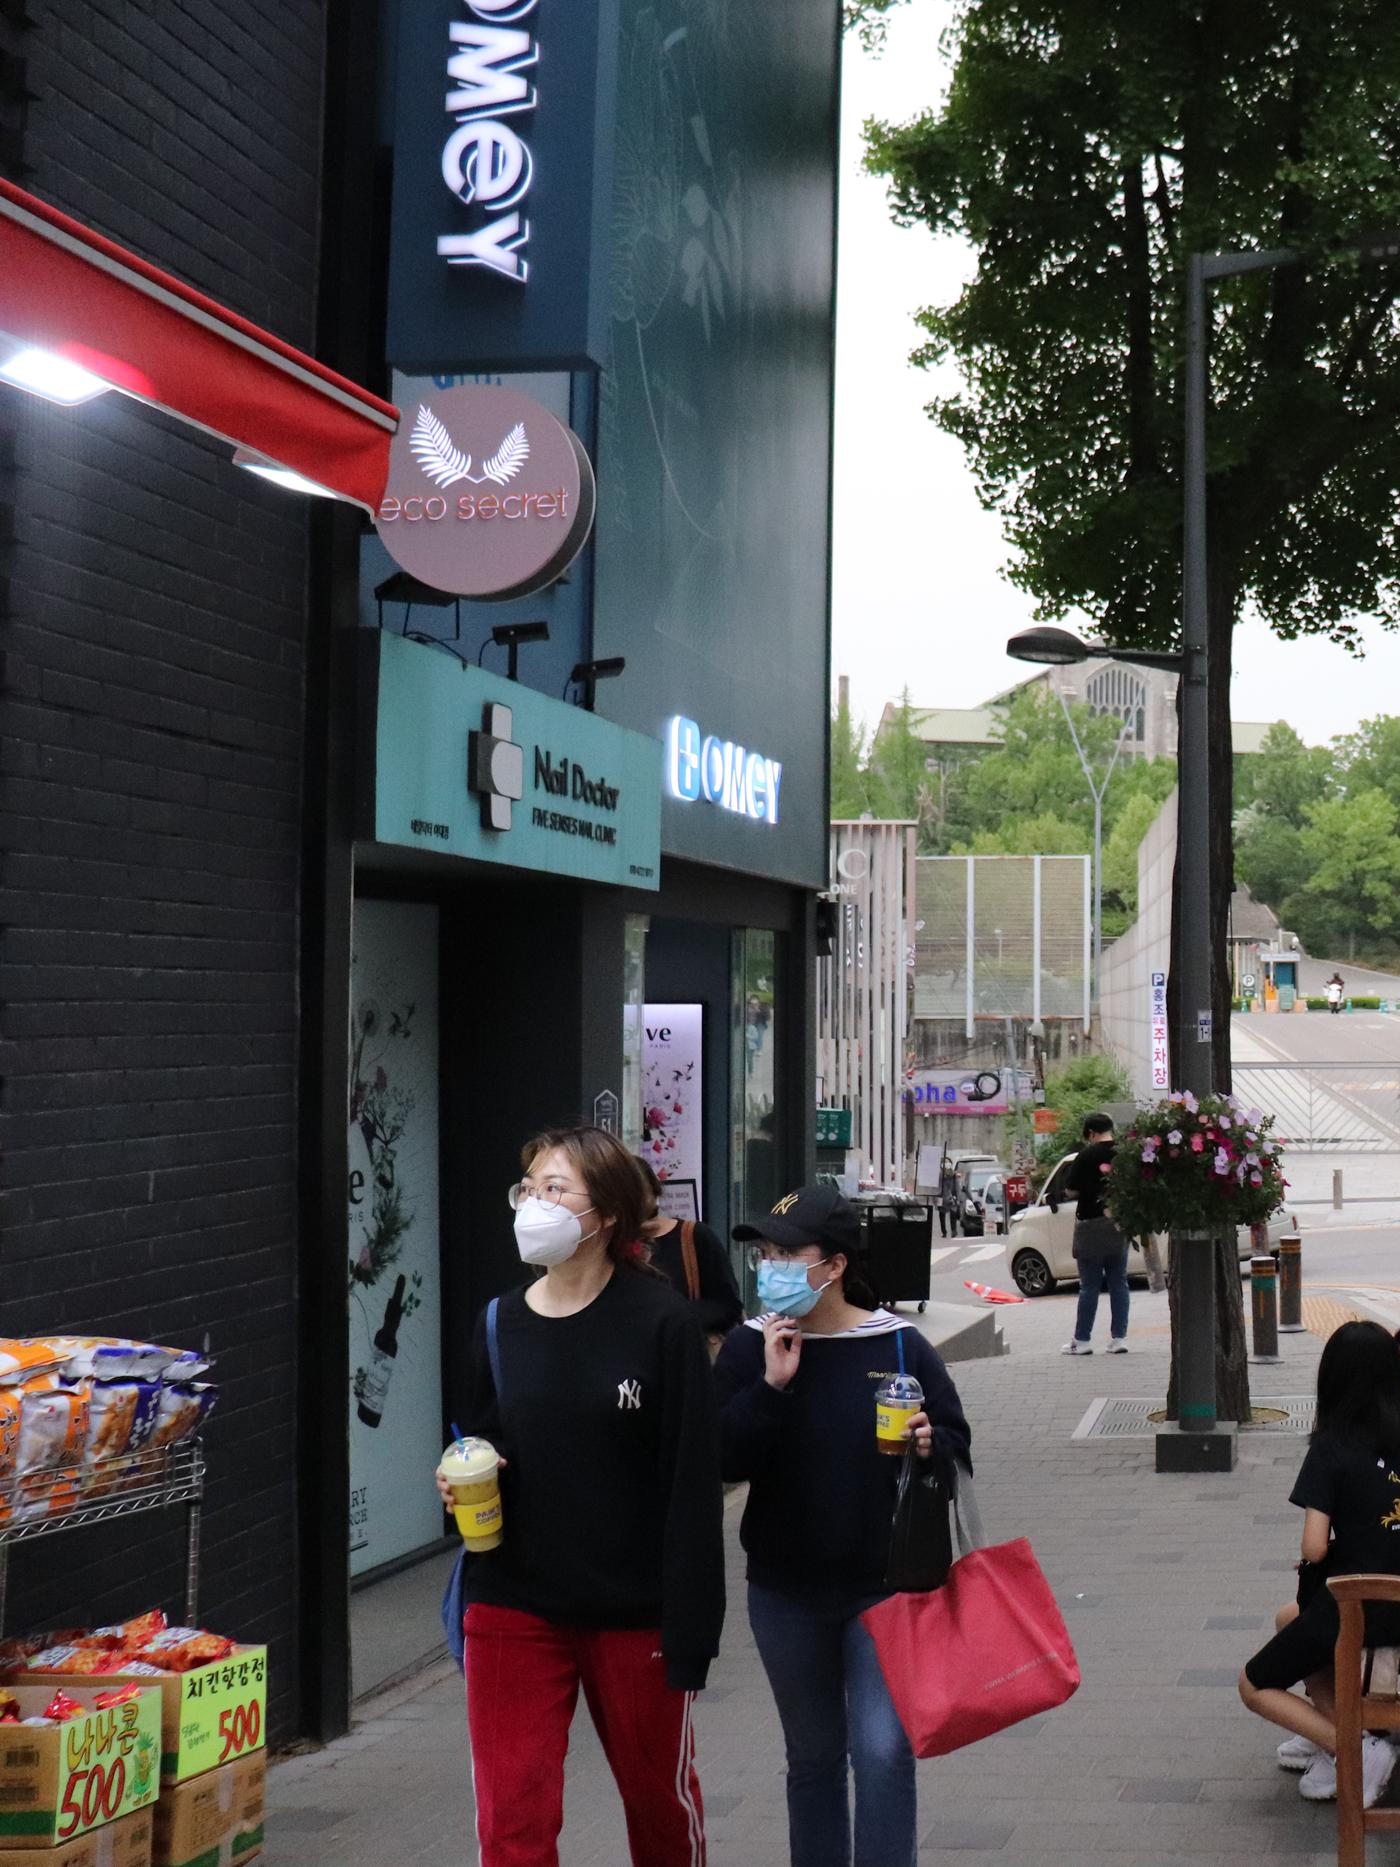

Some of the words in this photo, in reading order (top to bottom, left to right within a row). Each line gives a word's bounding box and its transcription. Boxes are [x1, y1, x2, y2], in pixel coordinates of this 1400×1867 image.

[379, 495, 447, 522] eco
[457, 487, 569, 521] secret
[534, 745, 569, 797] Nail
[572, 763, 620, 812] Doctor
[1153, 1027, 1167, 1085] 주차장
[1009, 1183, 1027, 1198] 구두
[67, 1702, 139, 1772] 나나콘
[219, 1698, 260, 1762] 500
[58, 1757, 126, 1837] 500
